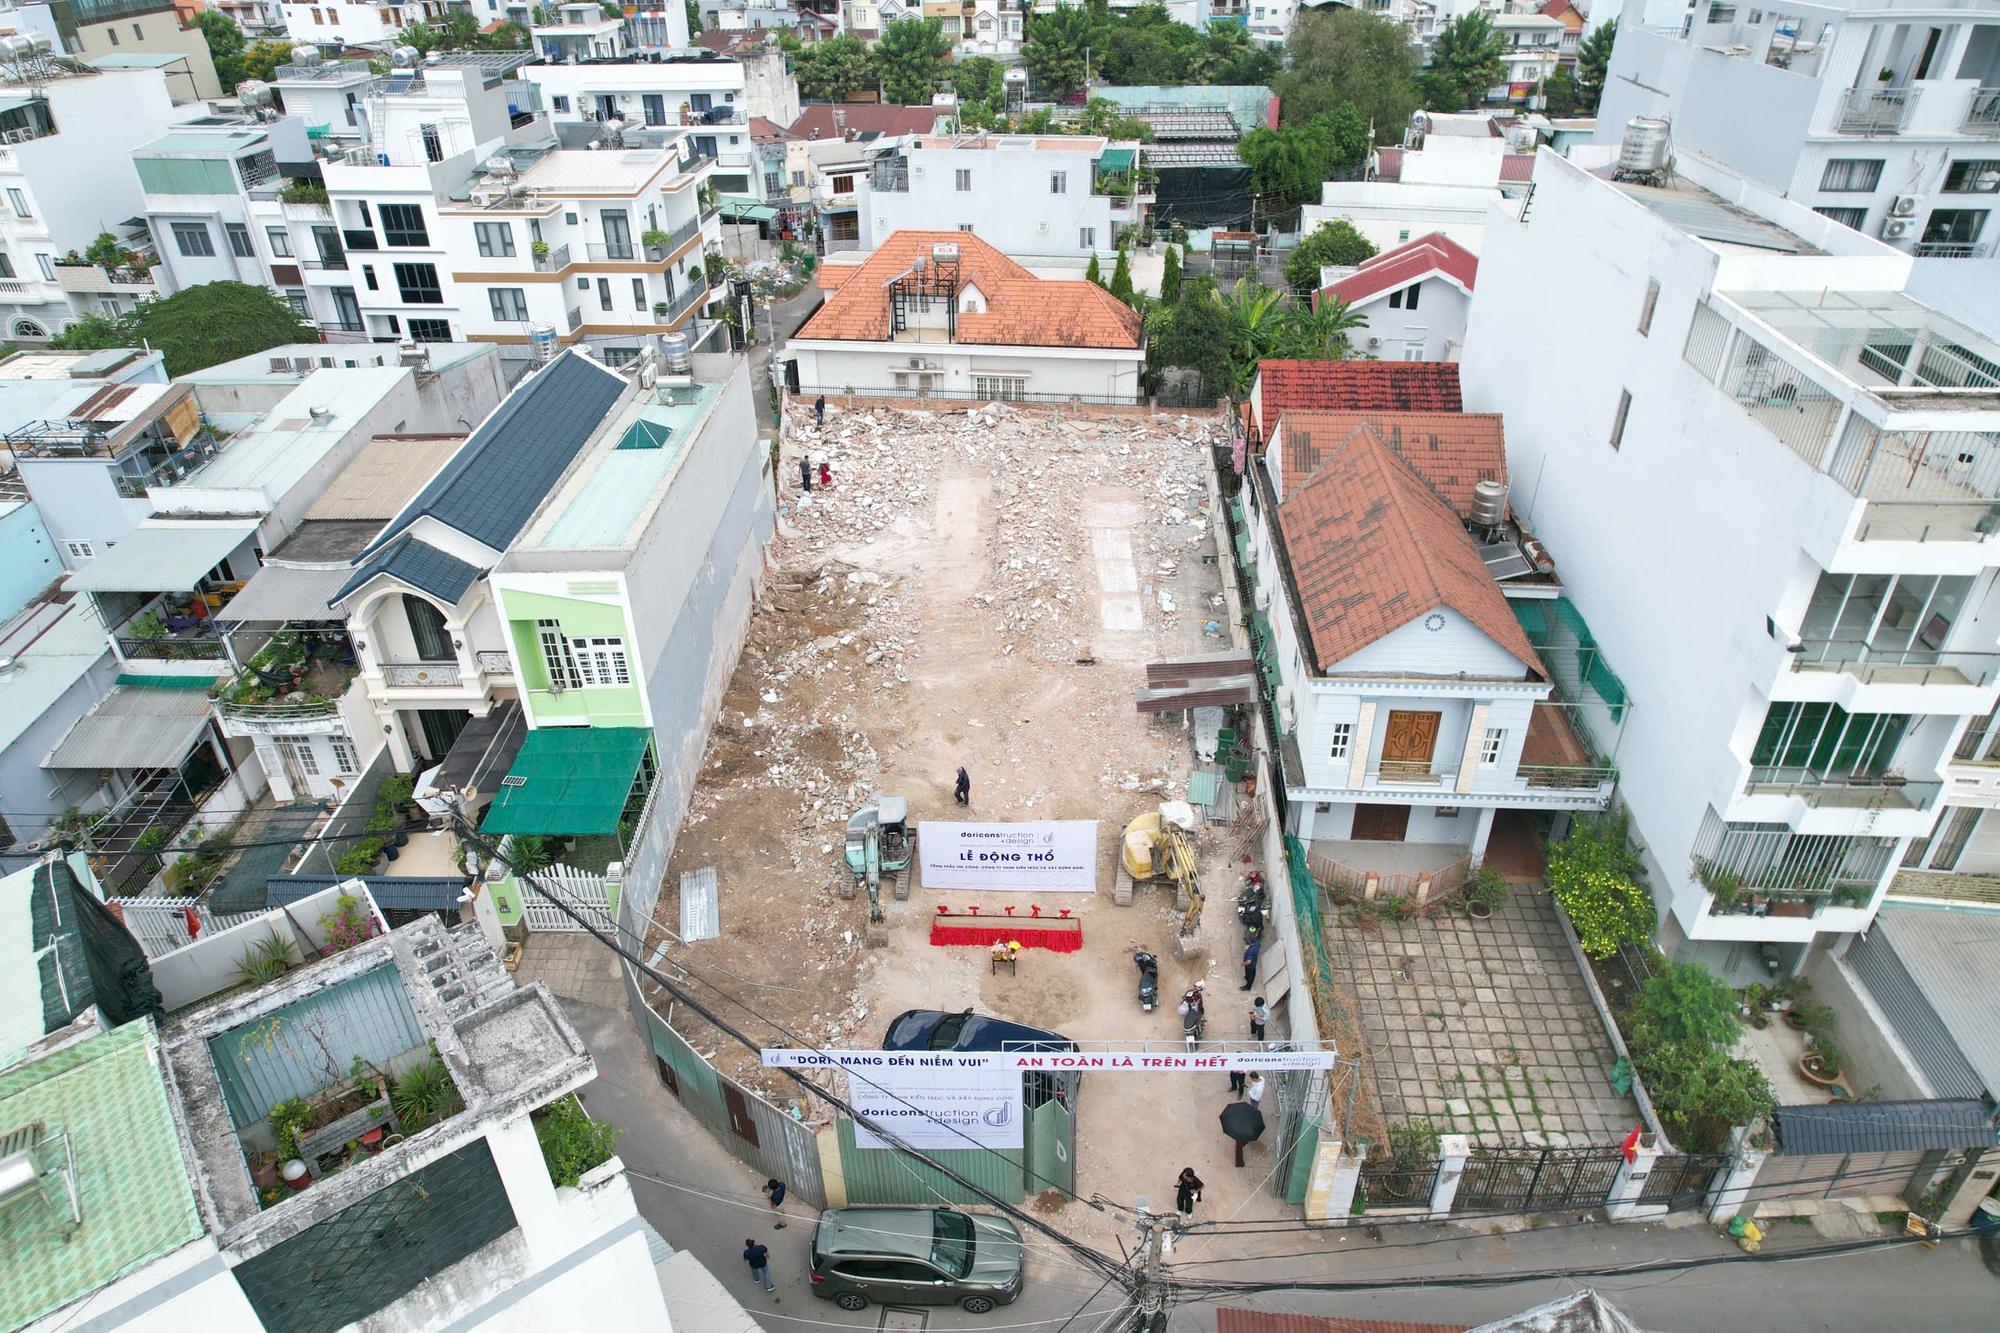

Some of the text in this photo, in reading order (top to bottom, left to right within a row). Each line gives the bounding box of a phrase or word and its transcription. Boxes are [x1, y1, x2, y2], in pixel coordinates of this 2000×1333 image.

[960, 848, 1055, 863] LỄ ĐỘNG THỔ
[840, 1056, 883, 1065] MANG
[888, 1054, 914, 1066] ĐẾN
[920, 1054, 953, 1067] NIỀM
[1016, 1055, 1228, 1067] AN TOÀN LÀ TRÊN HẾT
[861, 1108, 979, 1117] doriconstruction
